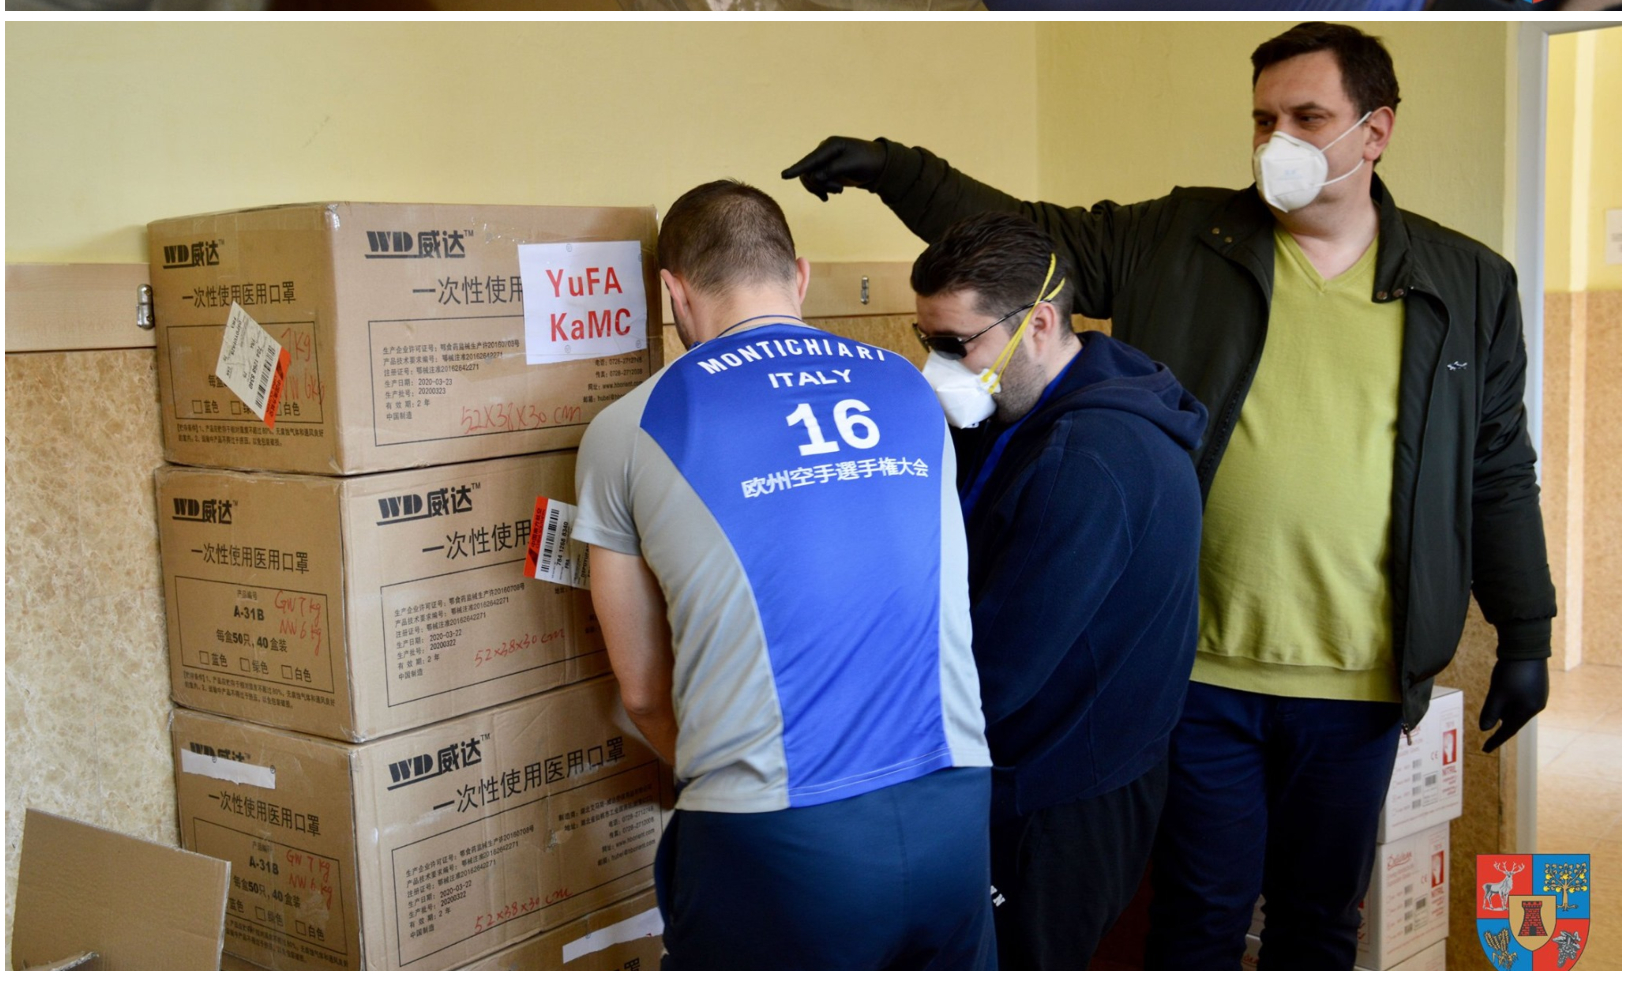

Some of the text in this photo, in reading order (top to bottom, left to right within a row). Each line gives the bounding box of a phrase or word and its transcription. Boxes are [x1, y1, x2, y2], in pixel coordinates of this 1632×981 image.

[182, 281, 296, 308] 一次性使用医用口罩
[546, 266, 623, 298] YuFA
[550, 308, 631, 342] KaMC
[698, 338, 885, 374] MONTICHIARI
[418, 378, 452, 386] 2020-03-23
[768, 369, 852, 388] ITALY
[786, 398, 881, 456] 16
[742, 458, 929, 498] 欧州空手選手権大会
[191, 543, 310, 574] 一次性使用医用口罩
[234, 605, 265, 621] A-31B
[430, 629, 462, 642] 2020-03-22
[430, 639, 456, 650] 20200322
[211, 653, 228, 668] 蓝色
[295, 668, 312, 682] 白色
[433, 736, 625, 814] 一次性使用医用口罩
[208, 790, 321, 837] 一次性使用医用口罩
[249, 856, 279, 876] A-31B
[440, 880, 472, 898] 2020-03-22
[440, 891, 466, 907] 20200322
[308, 925, 325, 942] 白色
